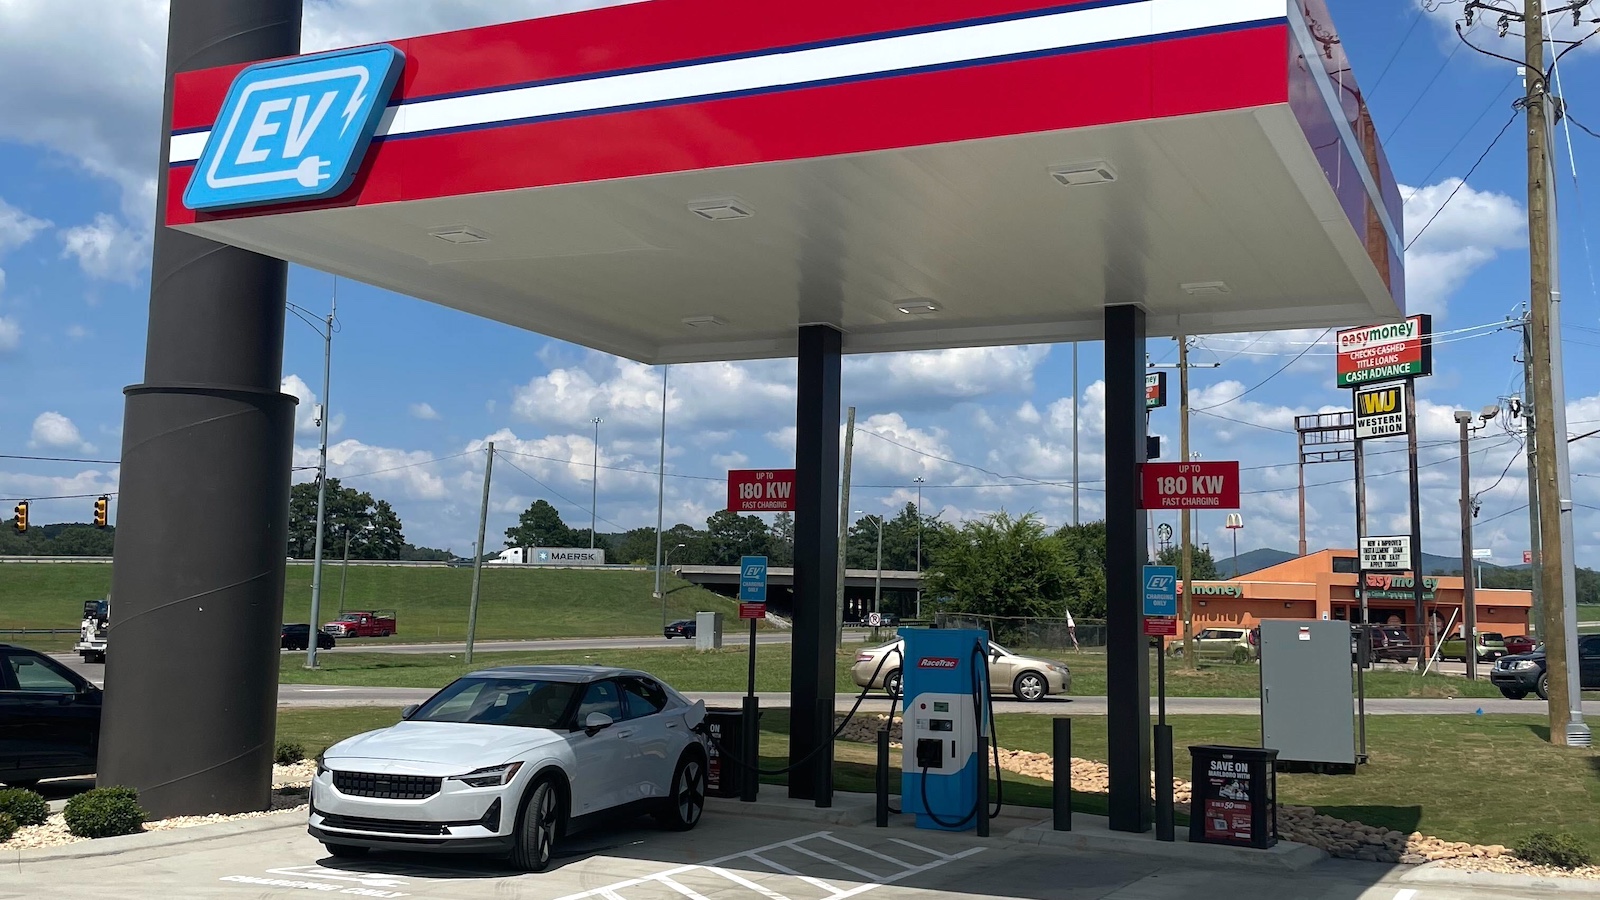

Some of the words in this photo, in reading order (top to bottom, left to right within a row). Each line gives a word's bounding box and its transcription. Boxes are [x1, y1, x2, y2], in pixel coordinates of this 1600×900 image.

[235, 91, 339, 165] EV
[1342, 322, 1414, 346] easymoney
[1350, 348, 1376, 360] CHECKS
[1377, 343, 1405, 354] CASHED
[1357, 358, 1374, 368] TITLE
[1375, 354, 1398, 366] LOANS
[1346, 371, 1368, 382] CASH
[1369, 363, 1410, 379] ADVANCE
[1358, 415, 1402, 427] WESTERN
[1372, 424, 1402, 434] UNION
[1179, 465, 1189, 474] UP
[1191, 464, 1200, 473] TO
[756, 472, 765, 480] UP
[739, 482, 763, 499] 180
[766, 482, 792, 499] KW
[1157, 477, 1187, 495] 180
[1192, 475, 1224, 494] KW
[742, 501, 756, 509] FAST
[757, 501, 787, 509] CHARGING
[1162, 498, 1180, 506] FAST
[1181, 497, 1219, 506] CHARGING
[551, 553, 595, 561] MAERSK
[747, 567, 760, 576] EV
[1152, 577, 1168, 587] EV
[1366, 575, 1439, 592] asymoey
[920, 658, 956, 668] RaceTrac
[710, 724, 720, 733] ON
[1210, 760, 1234, 771] SAVE
[1235, 763, 1248, 773] ON
[1208, 770, 1236, 779] MARLBORO
[219, 875, 344, 891] CHARGING
[340, 887, 411, 898] ONLY
